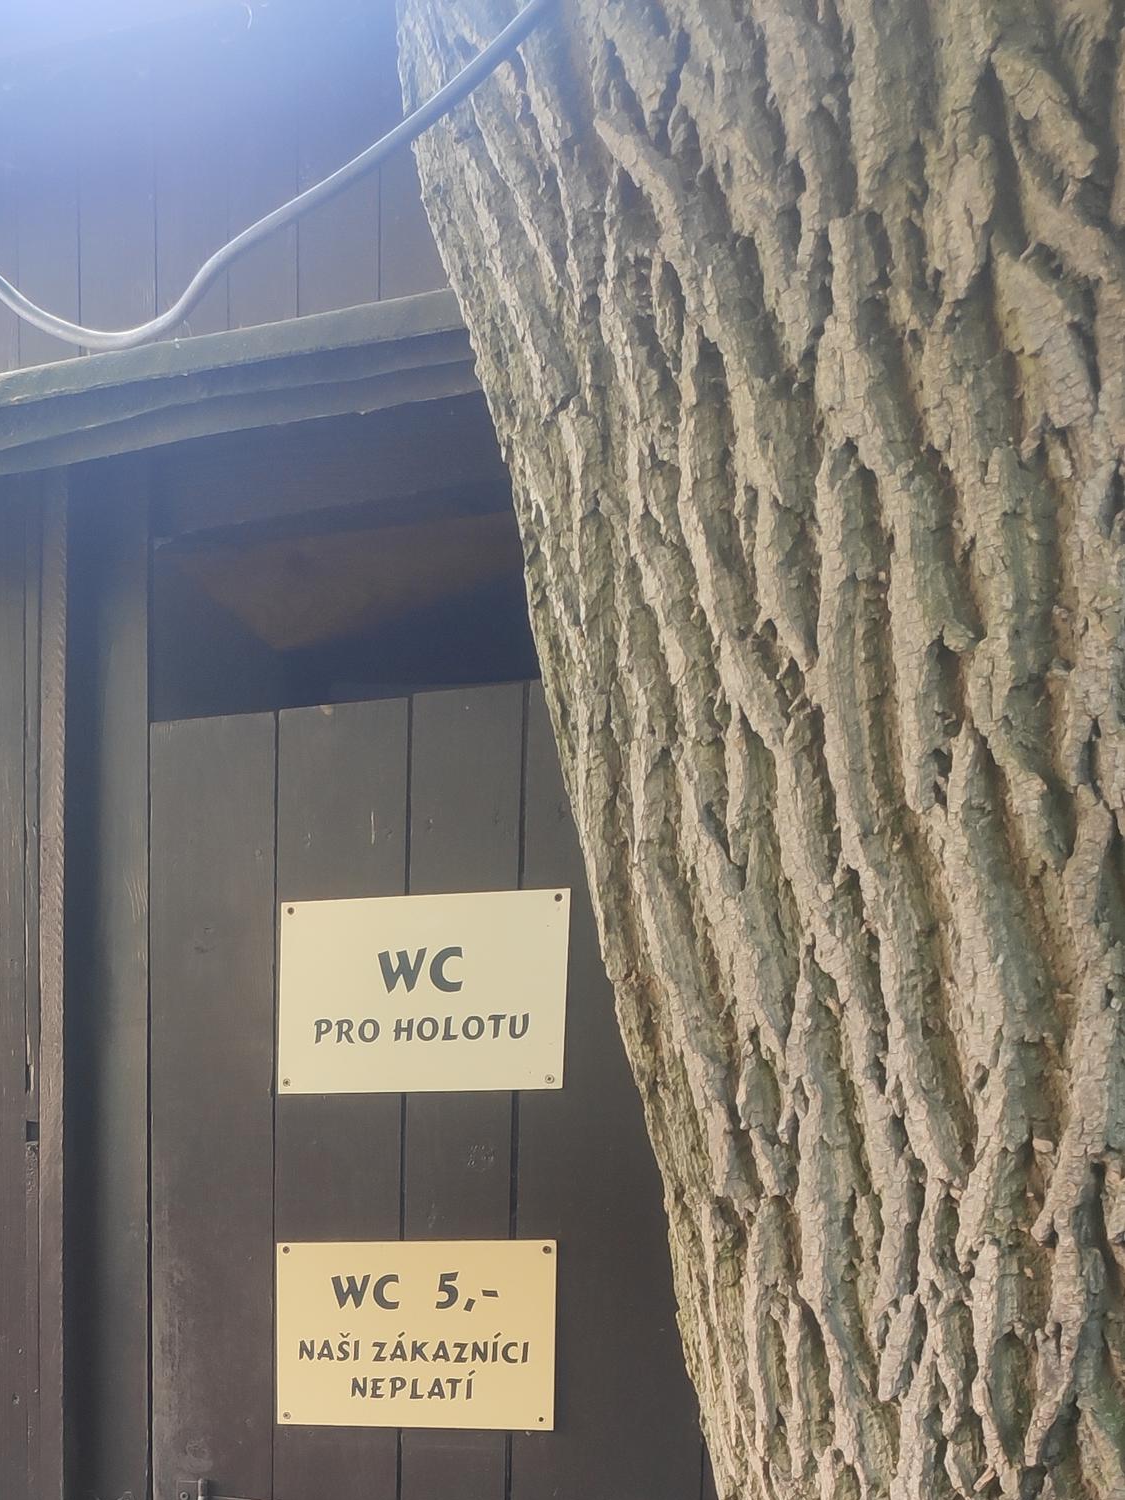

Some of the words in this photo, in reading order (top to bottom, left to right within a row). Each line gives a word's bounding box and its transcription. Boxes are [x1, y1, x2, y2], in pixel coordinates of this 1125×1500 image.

[377, 946, 463, 994] WC
[313, 1018, 381, 1045] PRO
[392, 1012, 530, 1042] HOLOTU
[330, 1273, 400, 1310] WC
[435, 1271, 500, 1313] 5,-
[298, 1331, 360, 1362] NAŠI
[371, 1331, 530, 1364] ZÁKAZNÍCI
[351, 1369, 476, 1401] NEPLATÍ
